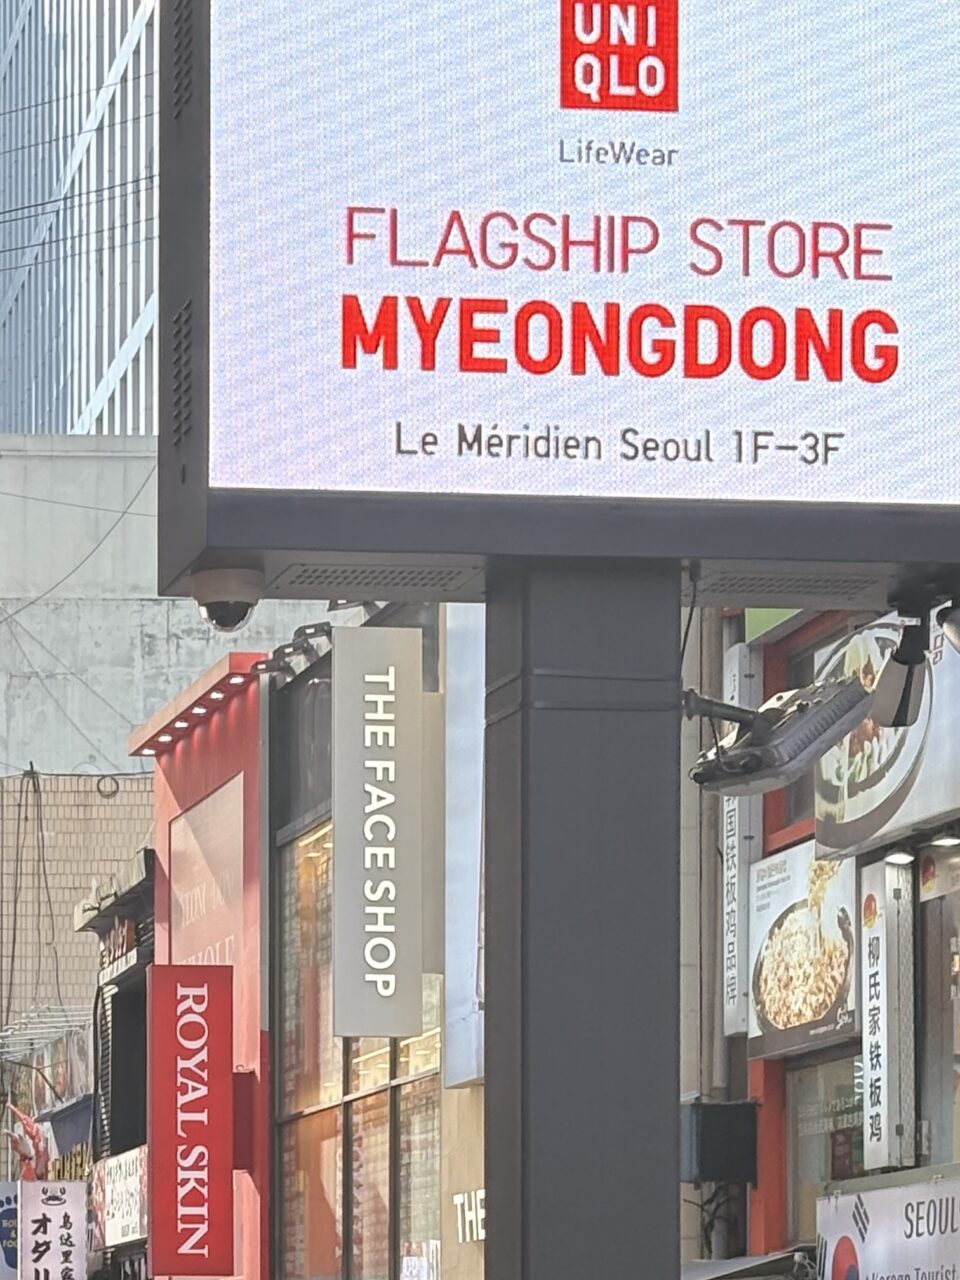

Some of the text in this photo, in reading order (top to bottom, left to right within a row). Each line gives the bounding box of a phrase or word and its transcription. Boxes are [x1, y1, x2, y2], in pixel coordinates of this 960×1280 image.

[574, 3, 657, 47] UNI
[574, 53, 665, 103] QLO
[559, 138, 679, 167] LifeWear
[346, 206, 893, 281] FLAGSHIP STORE
[341, 294, 899, 383] MYEONGDONG
[395, 421, 846, 466] Le Méridien Seoul 1F-3F
[363, 667, 396, 747] THE
[176, 983, 209, 1139] ROYAL
[176, 1144, 209, 1259] SKIN
[904, 1196, 959, 1240] SEOUL
